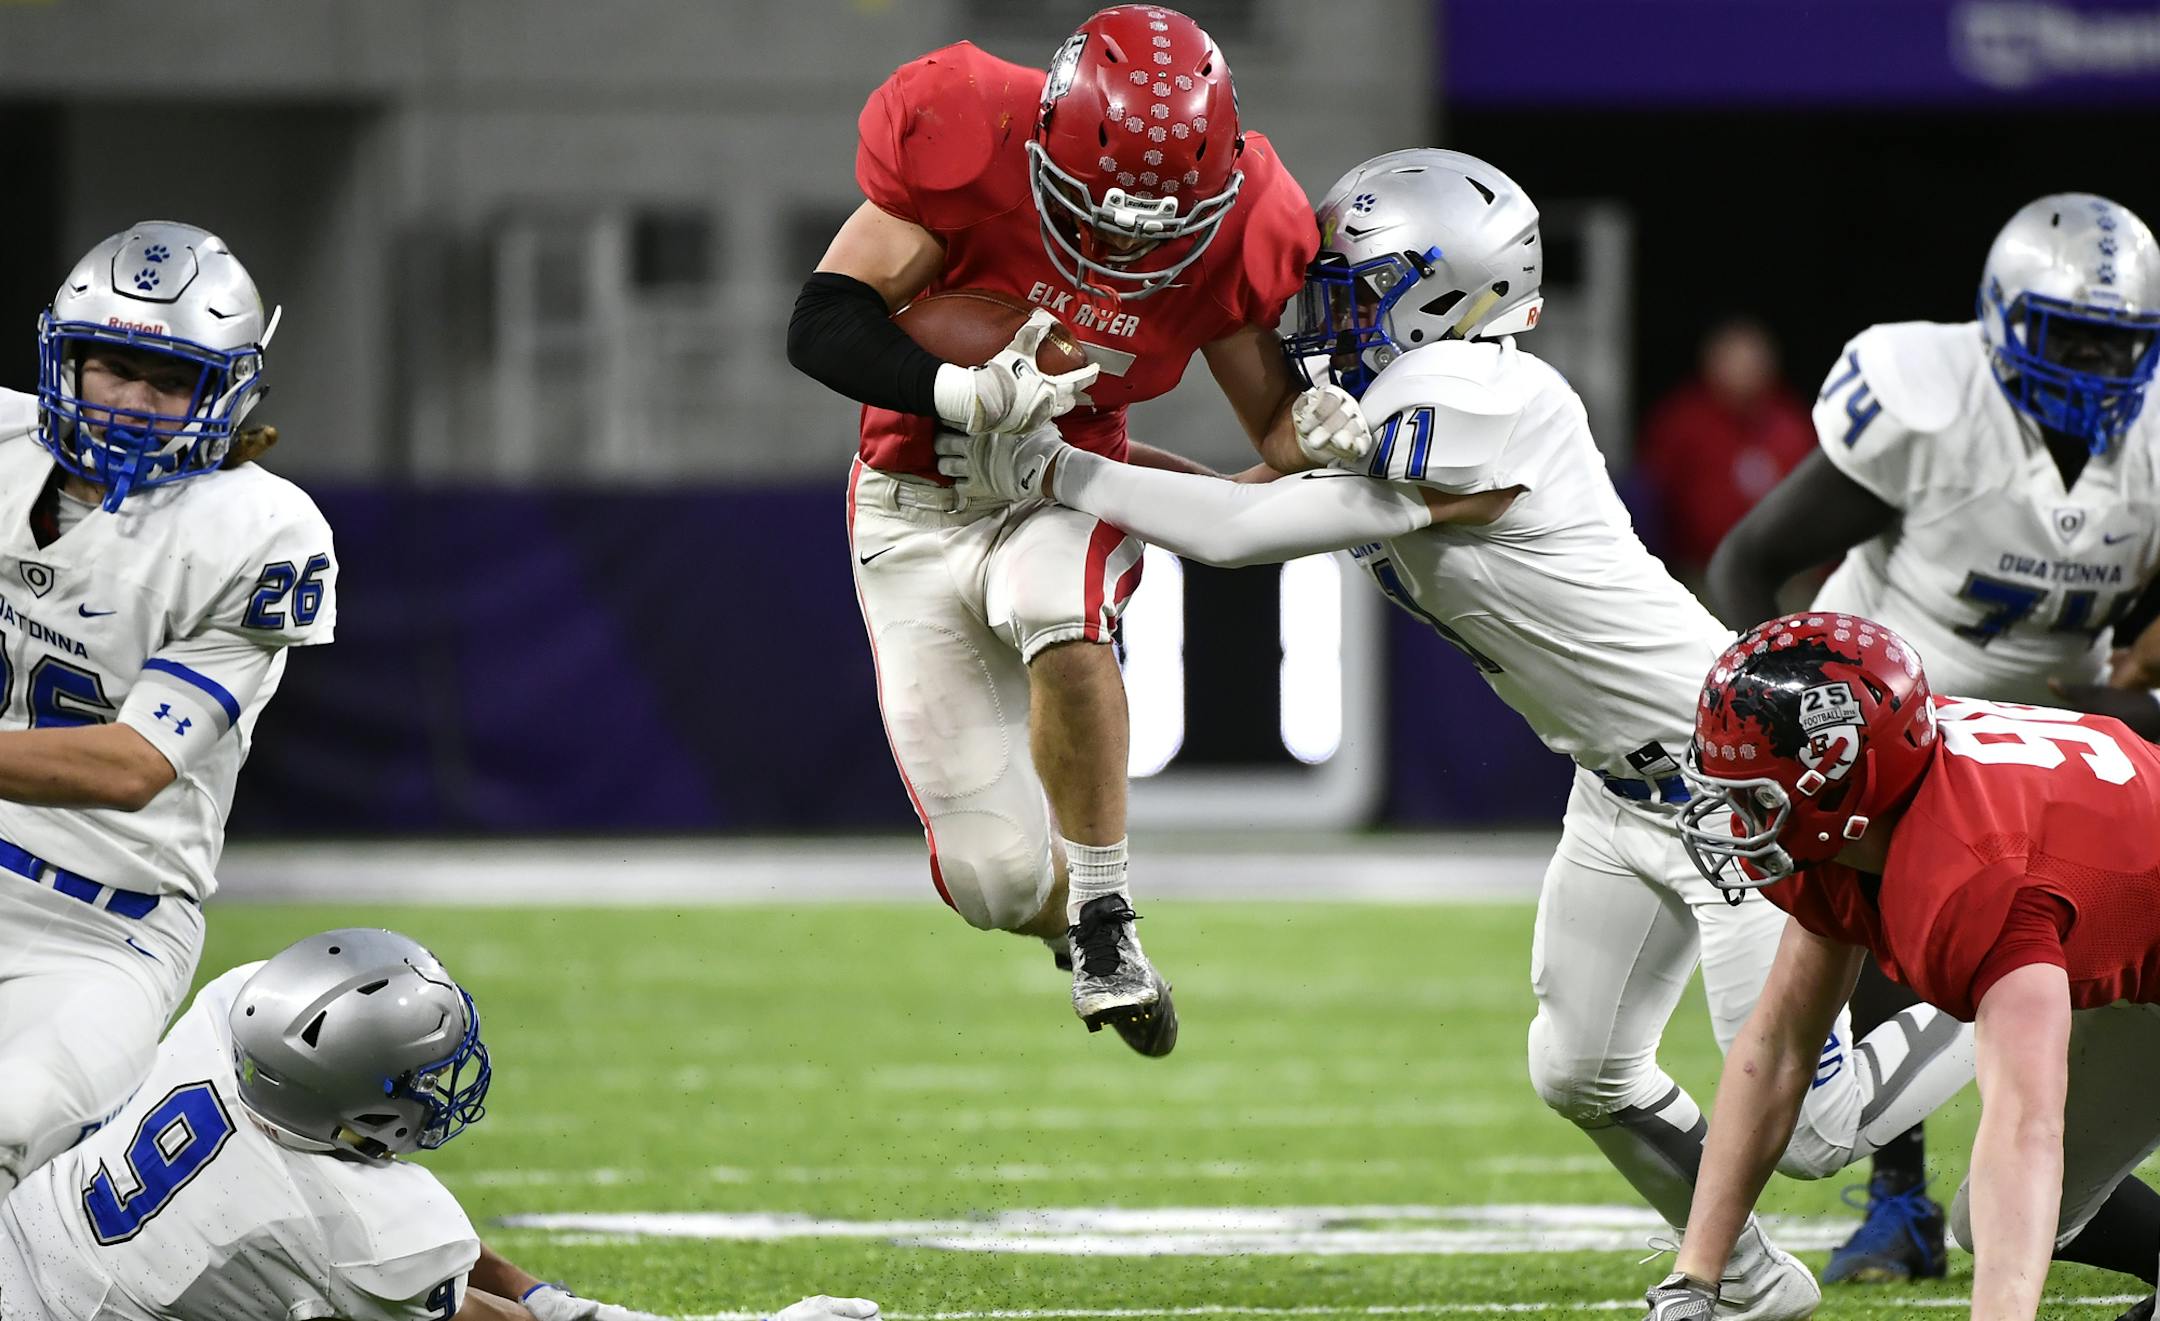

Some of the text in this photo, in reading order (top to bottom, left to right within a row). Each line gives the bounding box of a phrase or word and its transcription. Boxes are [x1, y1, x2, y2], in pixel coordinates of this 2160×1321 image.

[1125, 116, 1145, 133] PRIDE
[1151, 103, 1170, 120] PRIDE
[1148, 125, 1167, 142] PRIDE
[1144, 149, 1163, 166] PRIDE
[1027, 281, 1140, 337] ELK RIVER
[1819, 351, 1883, 450] 74
[1368, 406, 1436, 480] 11
[1999, 553, 2122, 583] OWATONNA
[241, 552, 330, 630] 26
[1804, 685, 1847, 712] 25
[1803, 709, 1841, 727] FOOTBALL
[82, 1080, 237, 1246] 9
[425, 1276, 456, 1321] 9
